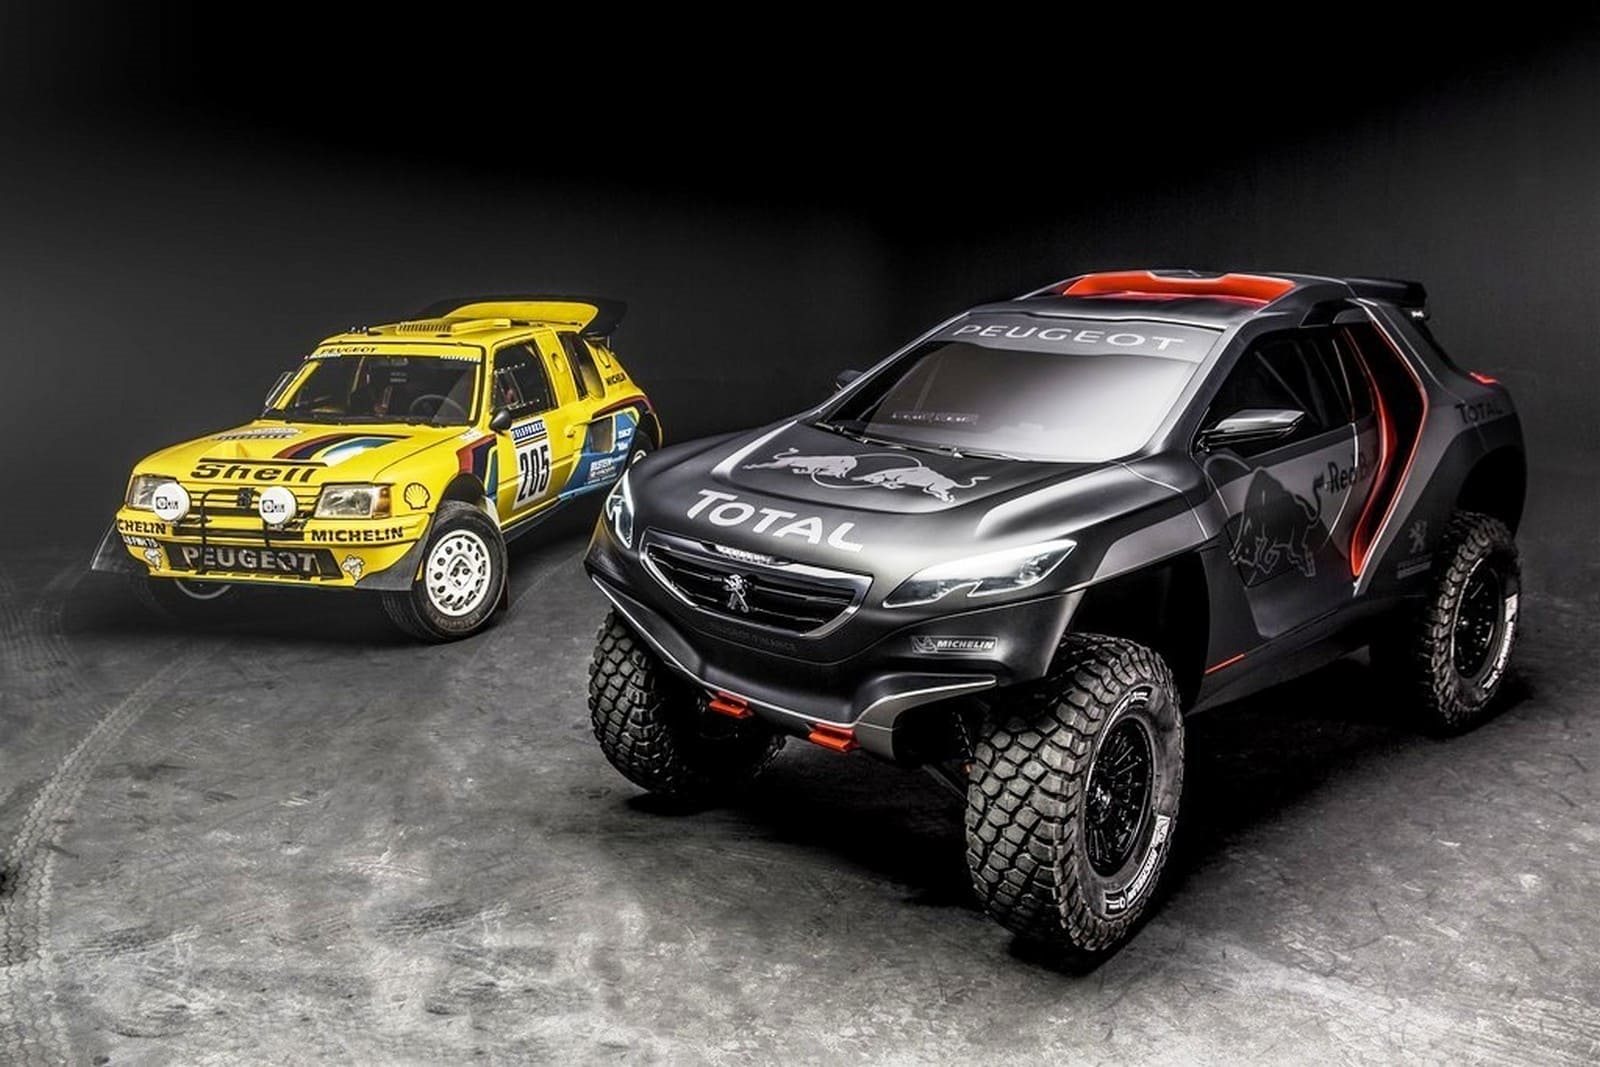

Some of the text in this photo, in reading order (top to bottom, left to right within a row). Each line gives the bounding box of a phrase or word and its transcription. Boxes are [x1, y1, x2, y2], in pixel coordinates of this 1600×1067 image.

[952, 325, 1184, 350] PEUGEOT
[321, 347, 378, 355] PEUGEOT
[190, 463, 317, 483] Shell
[518, 445, 549, 502] 205
[687, 489, 863, 552] TOTAL
[312, 527, 404, 542] MICHELIN
[182, 546, 317, 570] PEUGEOT
[937, 639, 995, 649] MICHELIN
